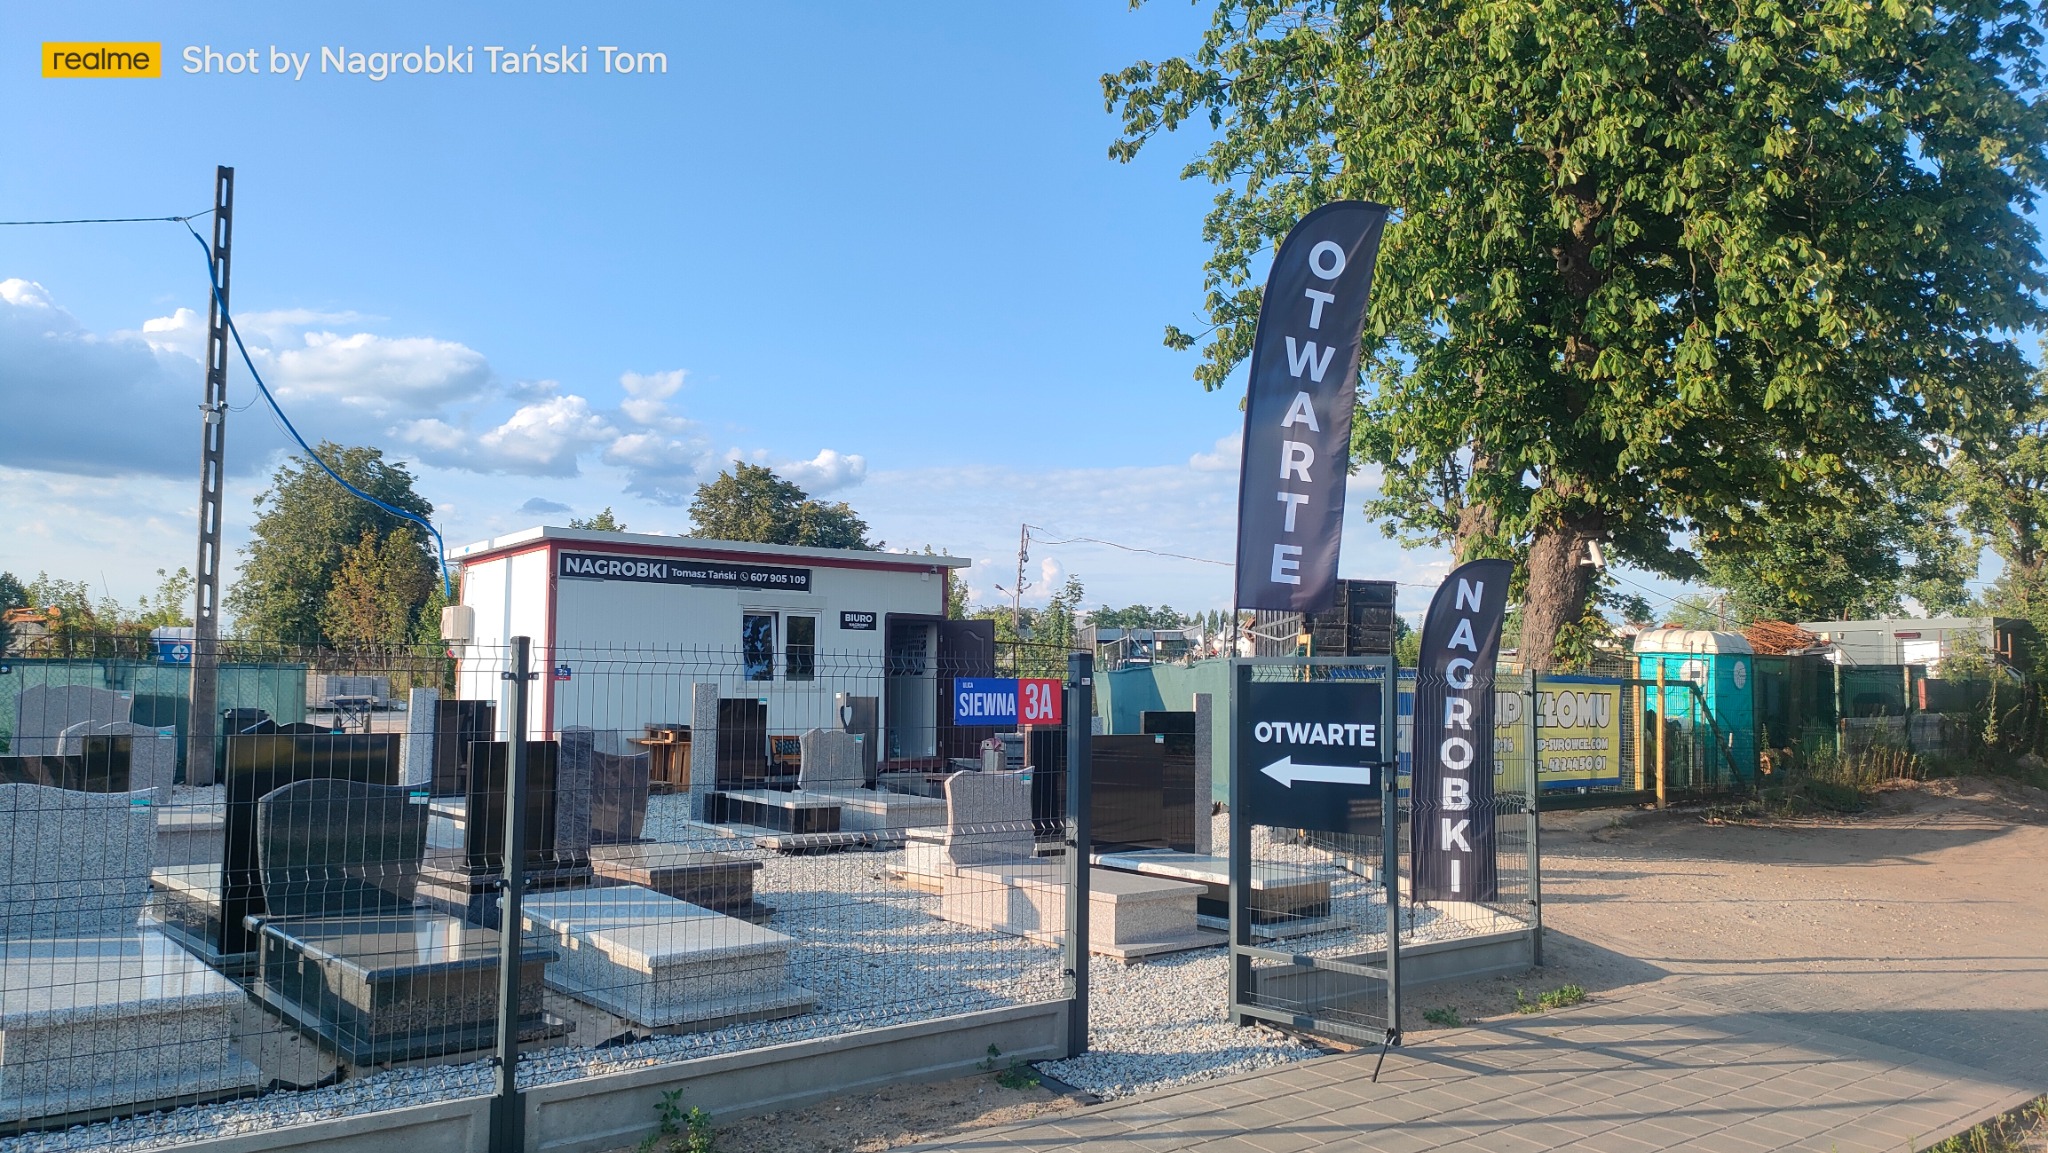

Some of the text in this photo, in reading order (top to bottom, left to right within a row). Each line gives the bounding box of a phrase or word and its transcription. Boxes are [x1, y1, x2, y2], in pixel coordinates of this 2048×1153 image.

[1269, 240, 1346, 585] OTWARTE
[565, 557, 806, 584] NAGROBKI Tomasz Tański 607 905 109
[845, 613, 873, 623] BIURO
[960, 683, 1053, 720] SIEWNA 3A
[1254, 721, 1376, 747] OTWARTE
[1440, 578, 1484, 893] NAGROBKI
